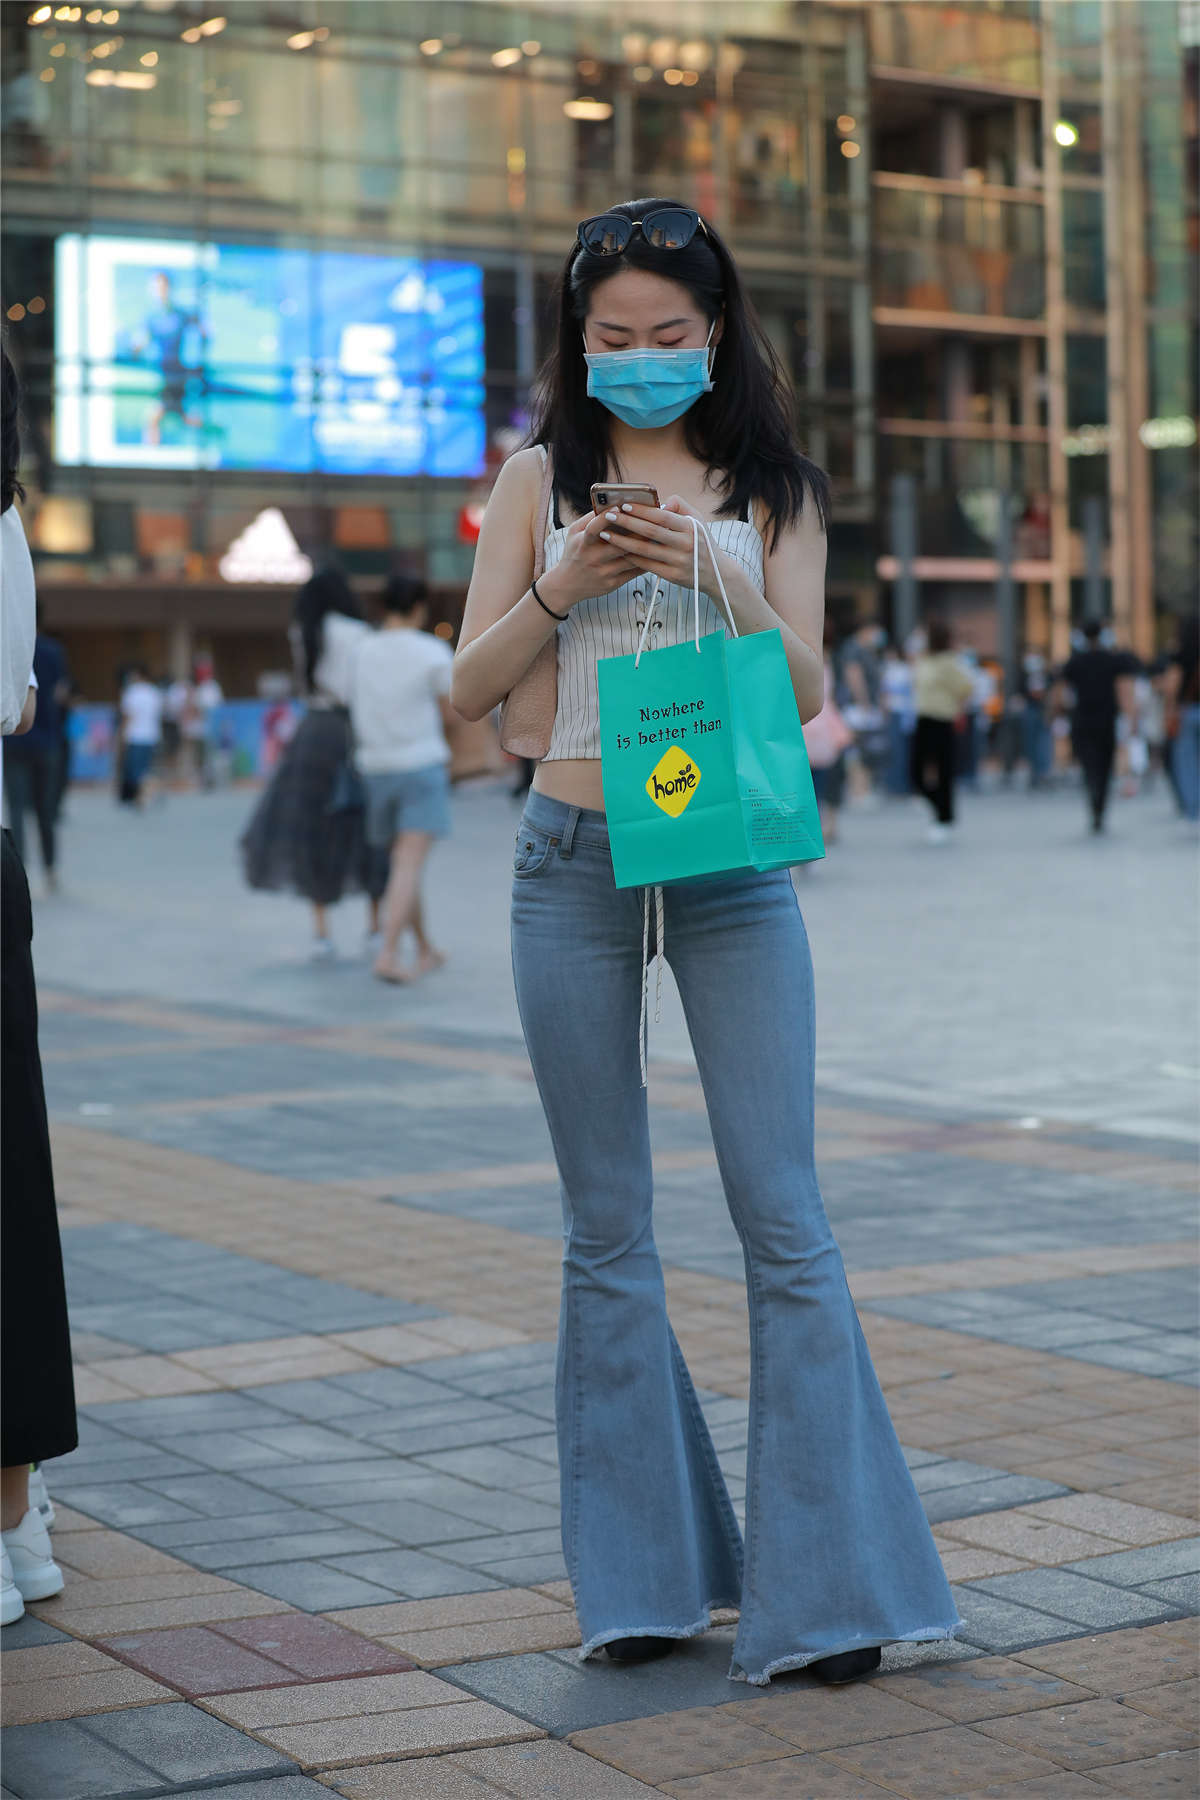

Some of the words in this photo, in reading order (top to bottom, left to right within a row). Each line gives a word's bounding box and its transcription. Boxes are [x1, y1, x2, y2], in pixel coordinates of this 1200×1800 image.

[639, 700, 705, 721] Nowhere
[616, 734, 631, 749] is
[638, 727, 687, 745] better
[693, 719, 721, 734] than
[651, 772, 697, 800] home
